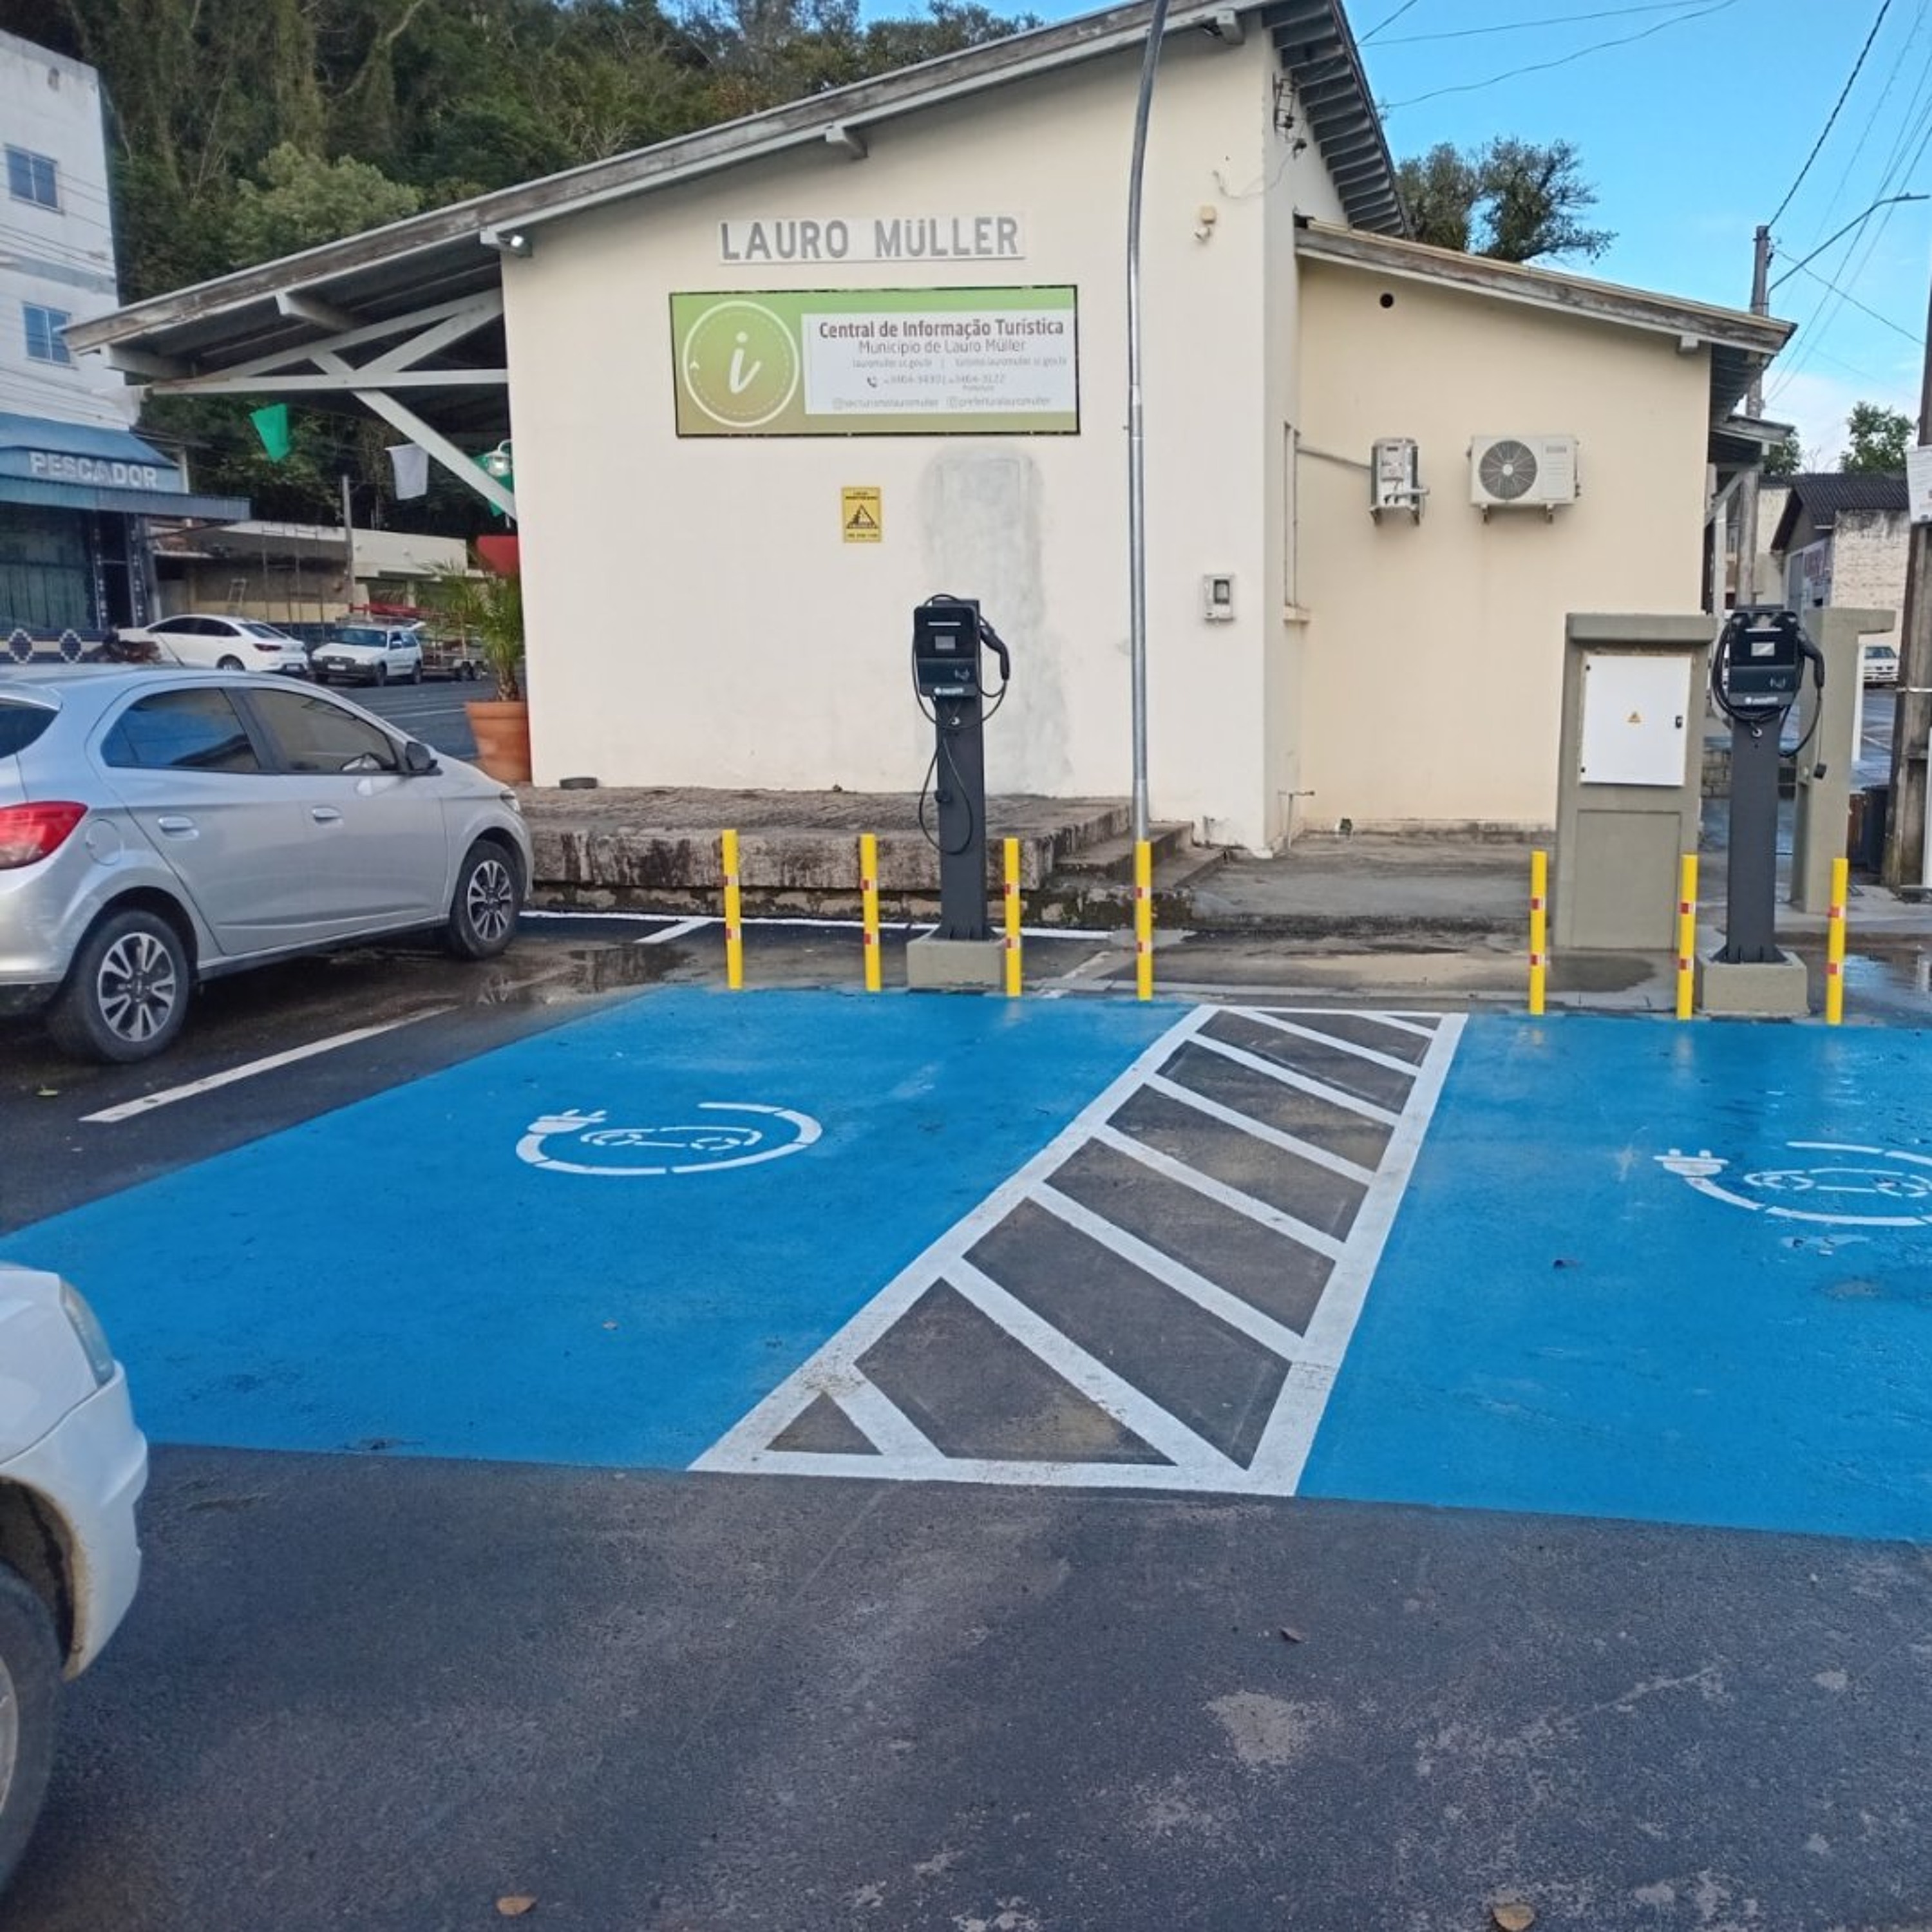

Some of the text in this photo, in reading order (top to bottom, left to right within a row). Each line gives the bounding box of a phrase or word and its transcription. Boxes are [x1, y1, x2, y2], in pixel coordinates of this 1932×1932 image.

[721, 217, 1018, 260] LAURO MÜLLER
[819, 321, 875, 339] Central
[880, 321, 898, 337] de
[903, 319, 991, 341] Informação
[925, 340, 941, 354] de
[944, 339, 981, 354] Lauro
[30, 451, 157, 488] PESCADOR
